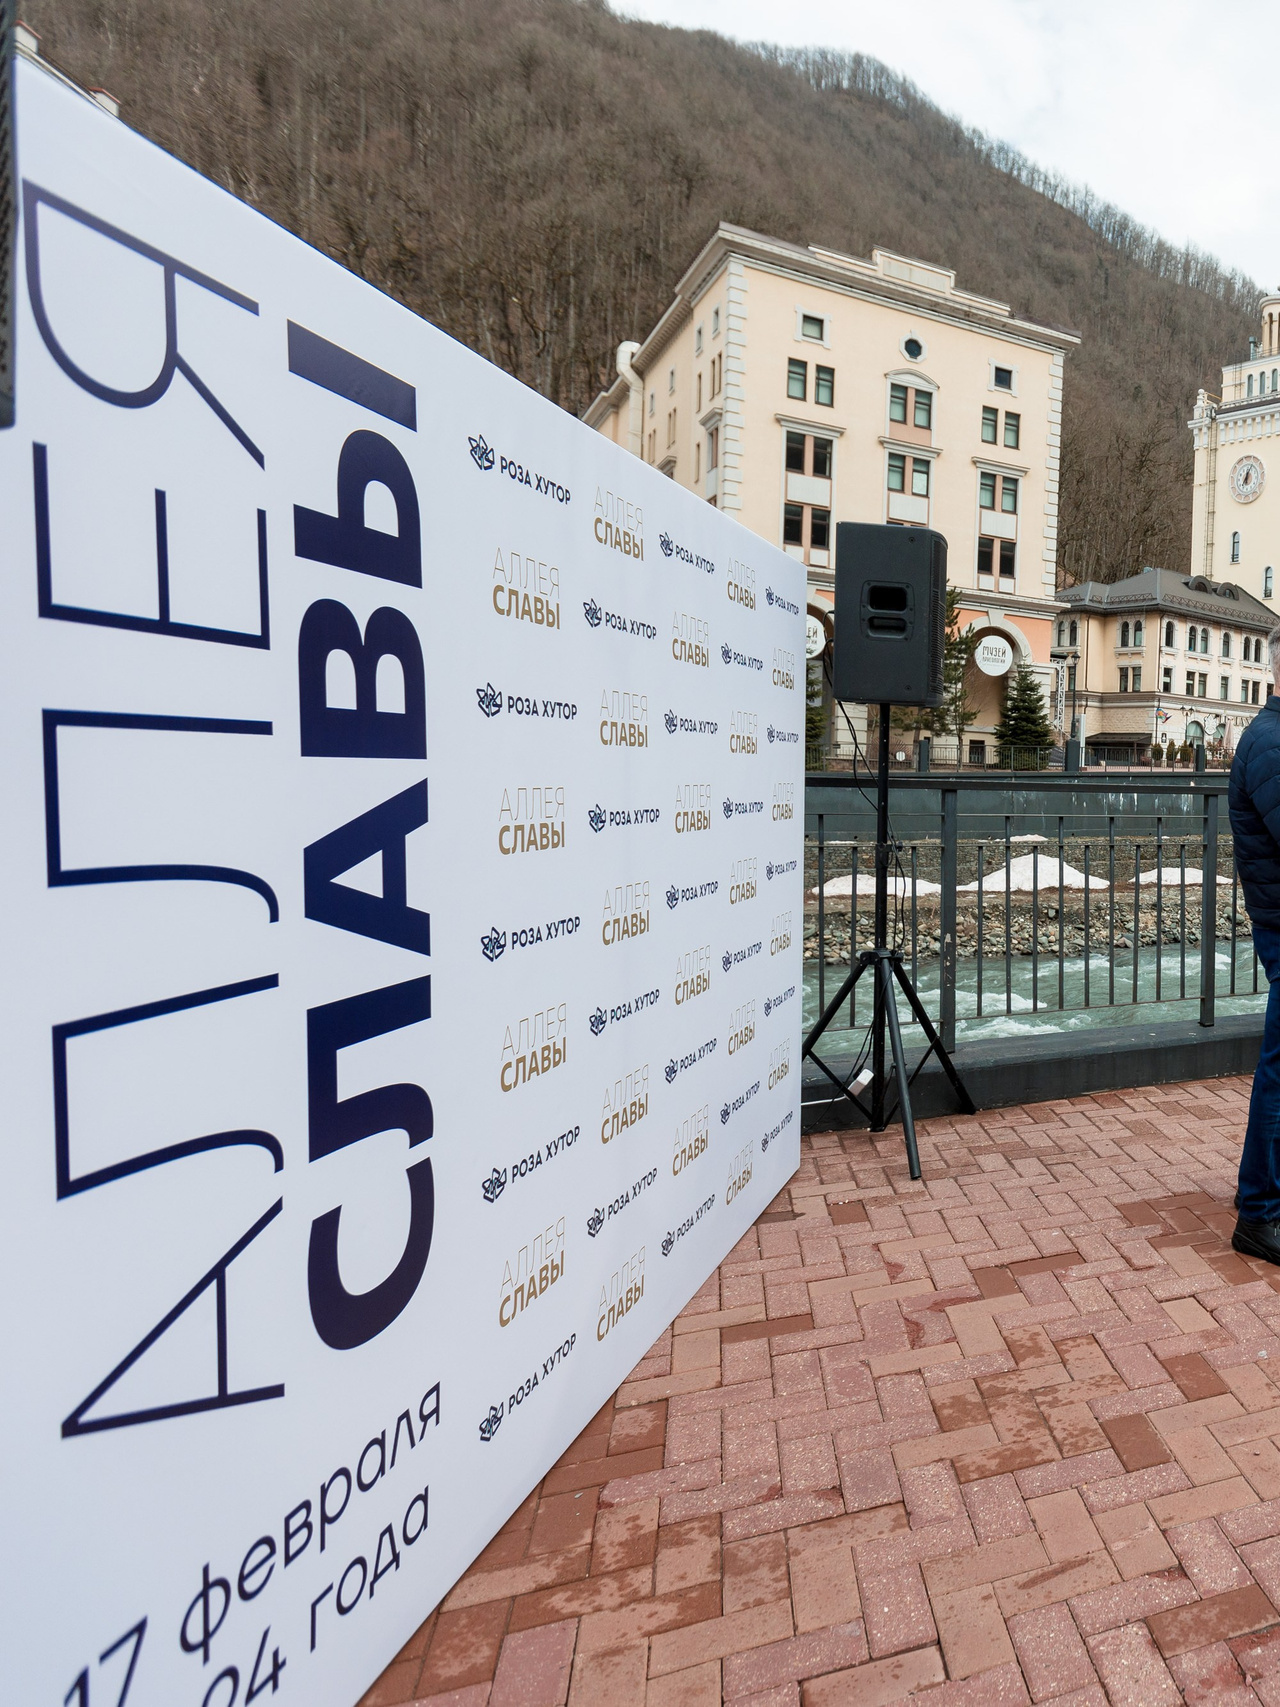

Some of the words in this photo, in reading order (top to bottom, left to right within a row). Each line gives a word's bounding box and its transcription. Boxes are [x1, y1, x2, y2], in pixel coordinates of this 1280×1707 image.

[500, 455, 531, 488] РОЗА
[535, 476, 571, 504] ХУТОР
[594, 486, 643, 534] АЛЛЕЯ
[594, 517, 644, 561] СЛАВЫ
[492, 548, 560, 599] АЛЛЕЯ
[676, 545, 694, 565] РОЗА
[695, 556, 715, 574] ХУТОР
[492, 584, 560, 629] СЛАВЫ
[727, 581, 756, 611] СЛАВЫ
[775, 595, 786, 608] РОЗА
[787, 601, 799, 616] ХУТОР
[605, 612, 628, 631] РОЗА
[630, 620, 657, 640] ХУТОР
[672, 611, 709, 644] АЛЛЕЯ
[672, 638, 709, 668] СЛАВЫ
[733, 652, 747, 667] РОЗА
[748, 657, 763, 671] ХУТОР
[982, 645, 1007, 658] МУЗЕЙ
[772, 668, 794, 691] СЛАВЫ
[508, 695, 539, 716] РОЗА
[542, 701, 578, 720] ХУТОР
[600, 689, 648, 721] АЛЛЕЯ
[600, 721, 648, 748] СЛАВЫ
[680, 718, 698, 732] РОЗА
[699, 721, 718, 734] ХУТОР
[777, 730, 787, 742] РОЗА
[788, 732, 799, 743] ХУТОР
[730, 734, 758, 754] СЛАВЫ
[22, 178, 285, 1435] АЛЛЕЯ
[499, 786, 565, 821] АЛЛЕЯ
[675, 784, 711, 808] АЛЛЕЯ
[735, 802, 748, 814] РОЗА
[749, 801, 763, 813] ХУТОР
[772, 802, 793, 821] СЛАВЫ
[287, 318, 435, 1350] СЛАВЫ
[609, 810, 632, 826] РОЗА
[633, 808, 660, 824] ХУТОР
[675, 810, 711, 833] СЛАВЫ
[498, 822, 565, 855] СЛАВЫ
[775, 862, 785, 875] РОЗА
[786, 860, 797, 872] ХУТОР
[602, 881, 649, 918] АЛЛЕЯ
[681, 887, 698, 902] РОЗА
[700, 881, 718, 898] ХУТОР
[730, 880, 757, 905] СЛАВЫ
[512, 927, 542, 950] РОЗА
[546, 916, 581, 940] ХУТОР
[602, 910, 649, 946] СЛАВЫ
[770, 931, 792, 957] СЛАВЫ
[675, 944, 711, 982] АЛЛЕЯ
[733, 949, 746, 964] РОЗА
[748, 941, 762, 958] ХУТОР
[675, 970, 710, 1005] СЛАВЫ
[772, 993, 783, 1008] РОЗА
[783, 986, 795, 1002] ХУТОР
[610, 1001, 632, 1024] РОЗА
[634, 989, 660, 1013] ХУТОР
[501, 1002, 567, 1061] АЛЛЕЯ
[728, 1022, 755, 1056] СЛАВЫ
[500, 1037, 566, 1092] СЛАВЫ
[679, 1050, 697, 1072] РОЗА
[698, 1038, 717, 1062] ХУТОР
[602, 1064, 648, 1118] АЛЛЕЯ
[768, 1058, 789, 1091] СЛАВЫ
[731, 1094, 745, 1115] РОЗА
[746, 1081, 760, 1104] ХУТОР
[601, 1093, 648, 1145] СЛАВЫ
[674, 1104, 708, 1152] АЛЛЕЯ
[770, 1122, 780, 1143] РОЗА
[781, 1111, 793, 1132] ХУТОР
[512, 1150, 542, 1184] РОЗА
[546, 1126, 580, 1161] ХУТОР
[672, 1129, 708, 1177] СЛАВЫ
[608, 1191, 630, 1221] РОЗА
[632, 1168, 658, 1199] ХУТОР
[726, 1162, 752, 1206] СЛАВЫ
[676, 1214, 694, 1242] РОЗА
[695, 1194, 716, 1222] ХУТОР
[500, 1216, 566, 1298] АЛЛЕЯ
[499, 1250, 564, 1328] СЛАВЫ
[598, 1245, 645, 1312] АЛЛЕЯ
[597, 1275, 644, 1342] СЛАВЫ
[508, 1371, 539, 1415] РОЗА
[542, 1332, 577, 1379] ХУТОР
[180, 1381, 441, 1667] февраля
[309, 1485, 429, 1653] года
